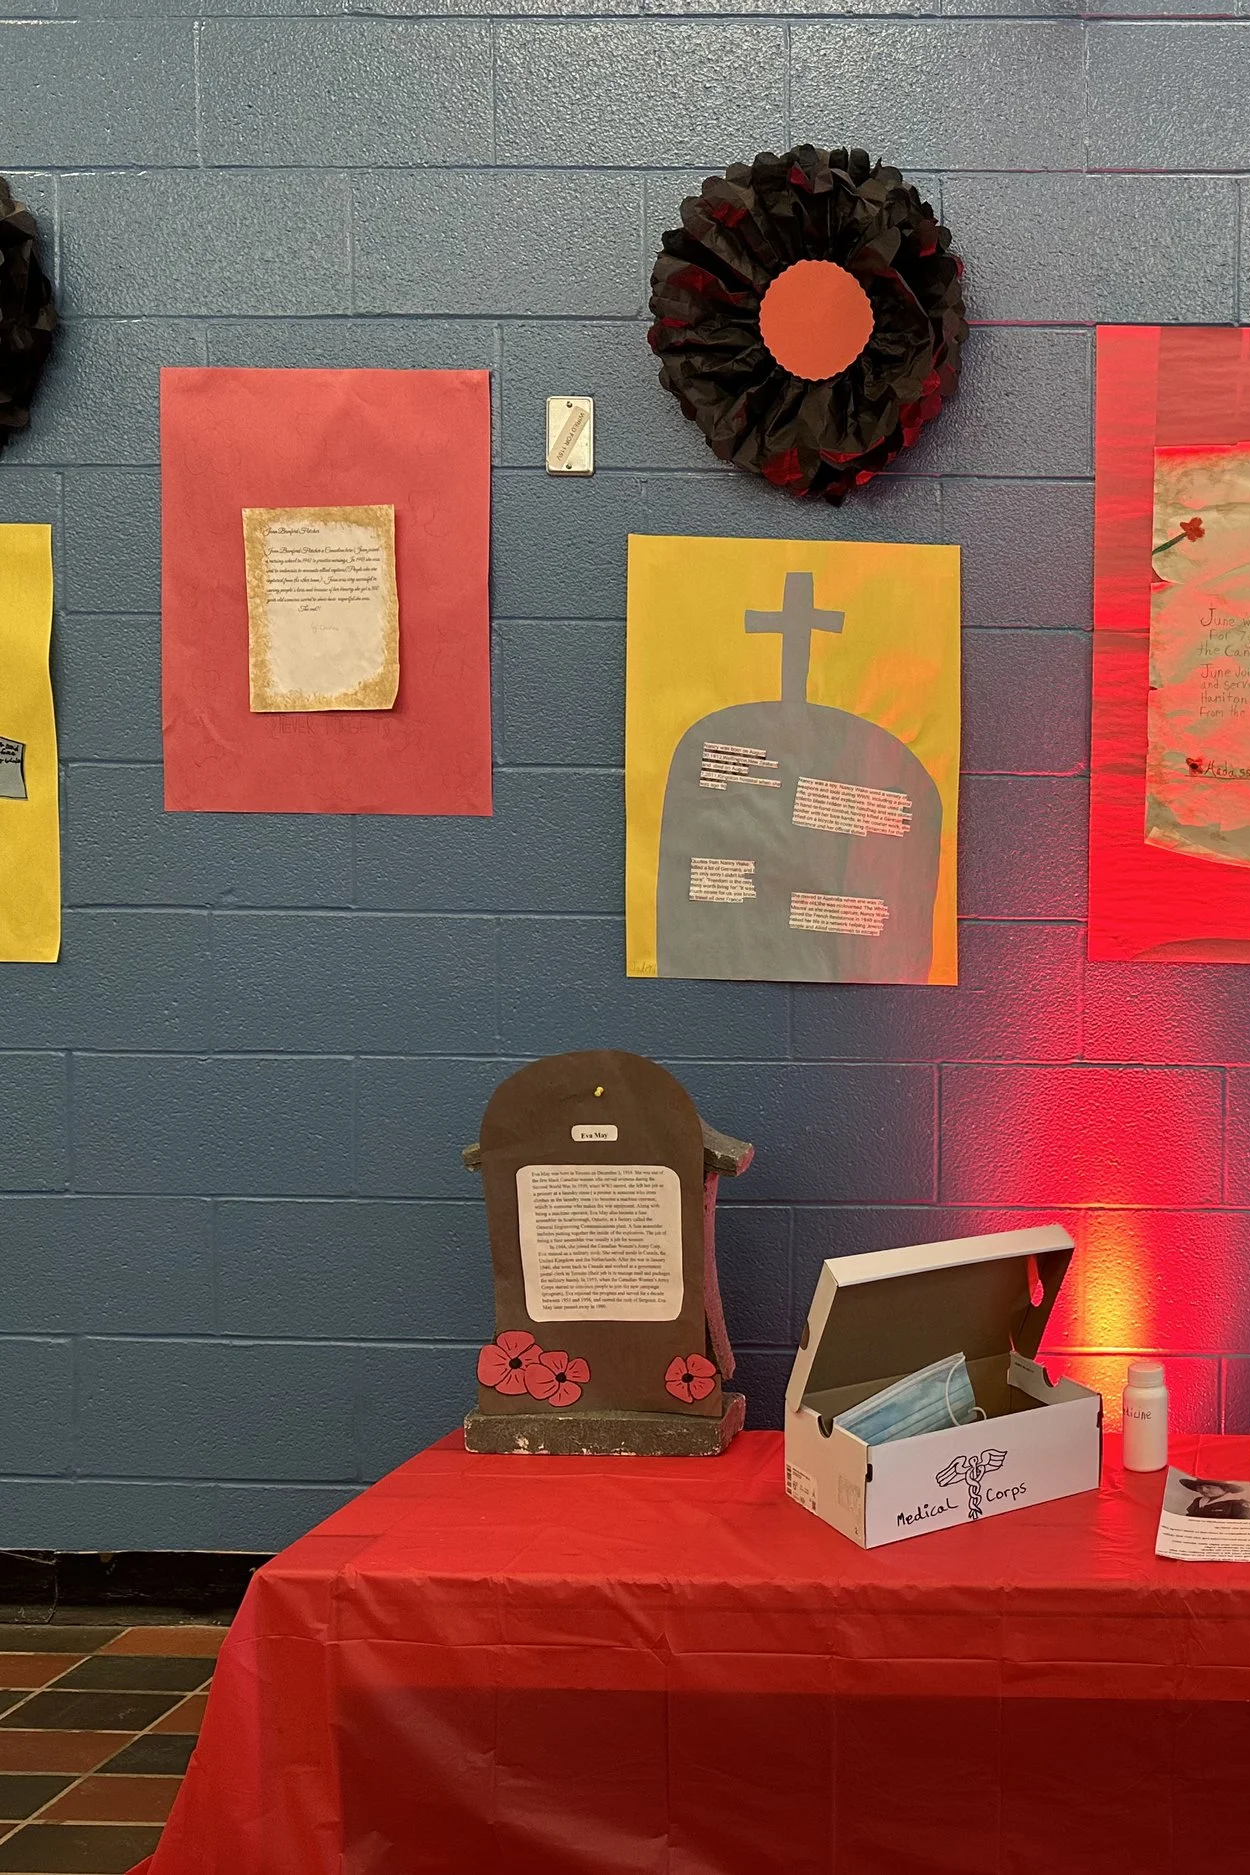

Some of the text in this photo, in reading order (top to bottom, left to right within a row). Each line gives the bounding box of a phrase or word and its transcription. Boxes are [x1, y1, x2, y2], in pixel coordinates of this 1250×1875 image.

[571, 412, 585, 433] WIRED
[564, 432, 575, 446] FOR
[1200, 608, 1235, 627] June
[1197, 640, 1221, 656] the
[1200, 663, 1231, 678] June
[1201, 678, 1219, 690] and
[1231, 704, 1246, 717] the
[897, 1482, 1027, 1527] Medical Corps
